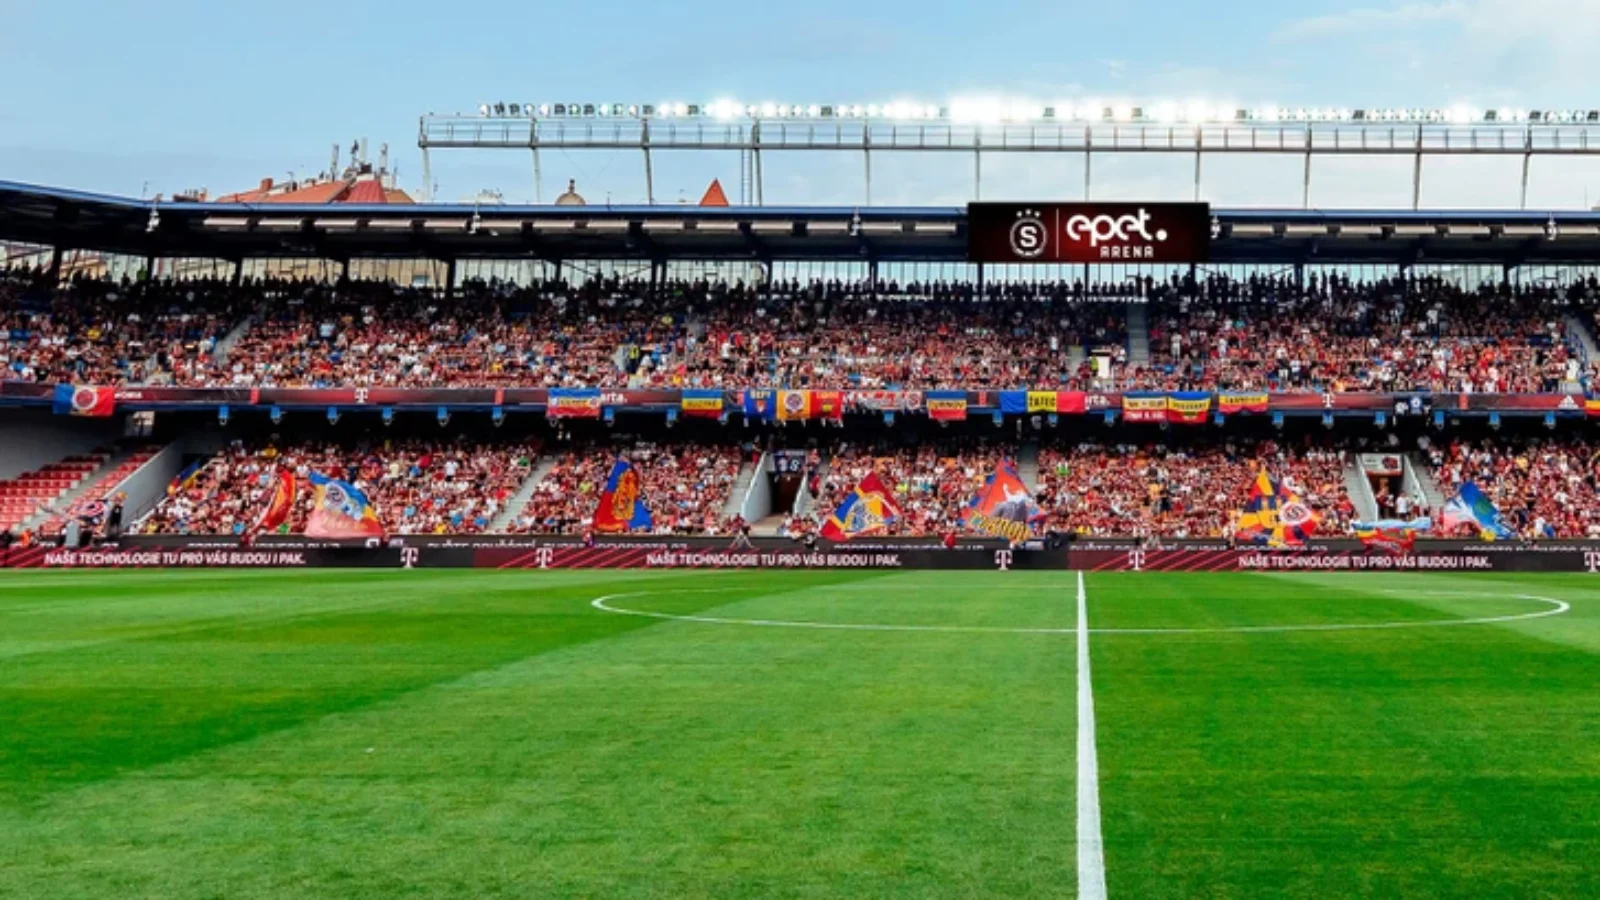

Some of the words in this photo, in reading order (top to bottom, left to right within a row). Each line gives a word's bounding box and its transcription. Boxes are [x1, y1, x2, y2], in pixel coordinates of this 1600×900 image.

[1066, 208, 1168, 247] epet.
[1019, 225, 1038, 248] S
[1100, 245, 1154, 258] ARENA
[44, 550, 77, 564] NAŠE
[80, 552, 160, 564] TECHNOLOGIE
[163, 552, 179, 564] TU
[180, 552, 203, 564] PRO
[205, 550, 227, 564] VÁS
[229, 552, 271, 564] BUDOU
[280, 552, 306, 564] PAK.
[646, 551, 677, 566] NAŠE
[679, 554, 758, 566] TECHNOLOGIE
[761, 554, 776, 566] TU
[778, 554, 801, 566] PRO
[803, 551, 825, 566] VÁS
[827, 554, 868, 566] BUDOU
[875, 554, 902, 566] PAK.
[1239, 553, 1269, 568] NAŠE
[1272, 556, 1349, 568] TECHNOLOGIE
[1352, 556, 1367, 568] TU
[1368, 556, 1392, 568] PRO
[1393, 553, 1416, 568] VÁS
[1417, 556, 1458, 568] BUDOU
[1465, 556, 1492, 568] PAK.
